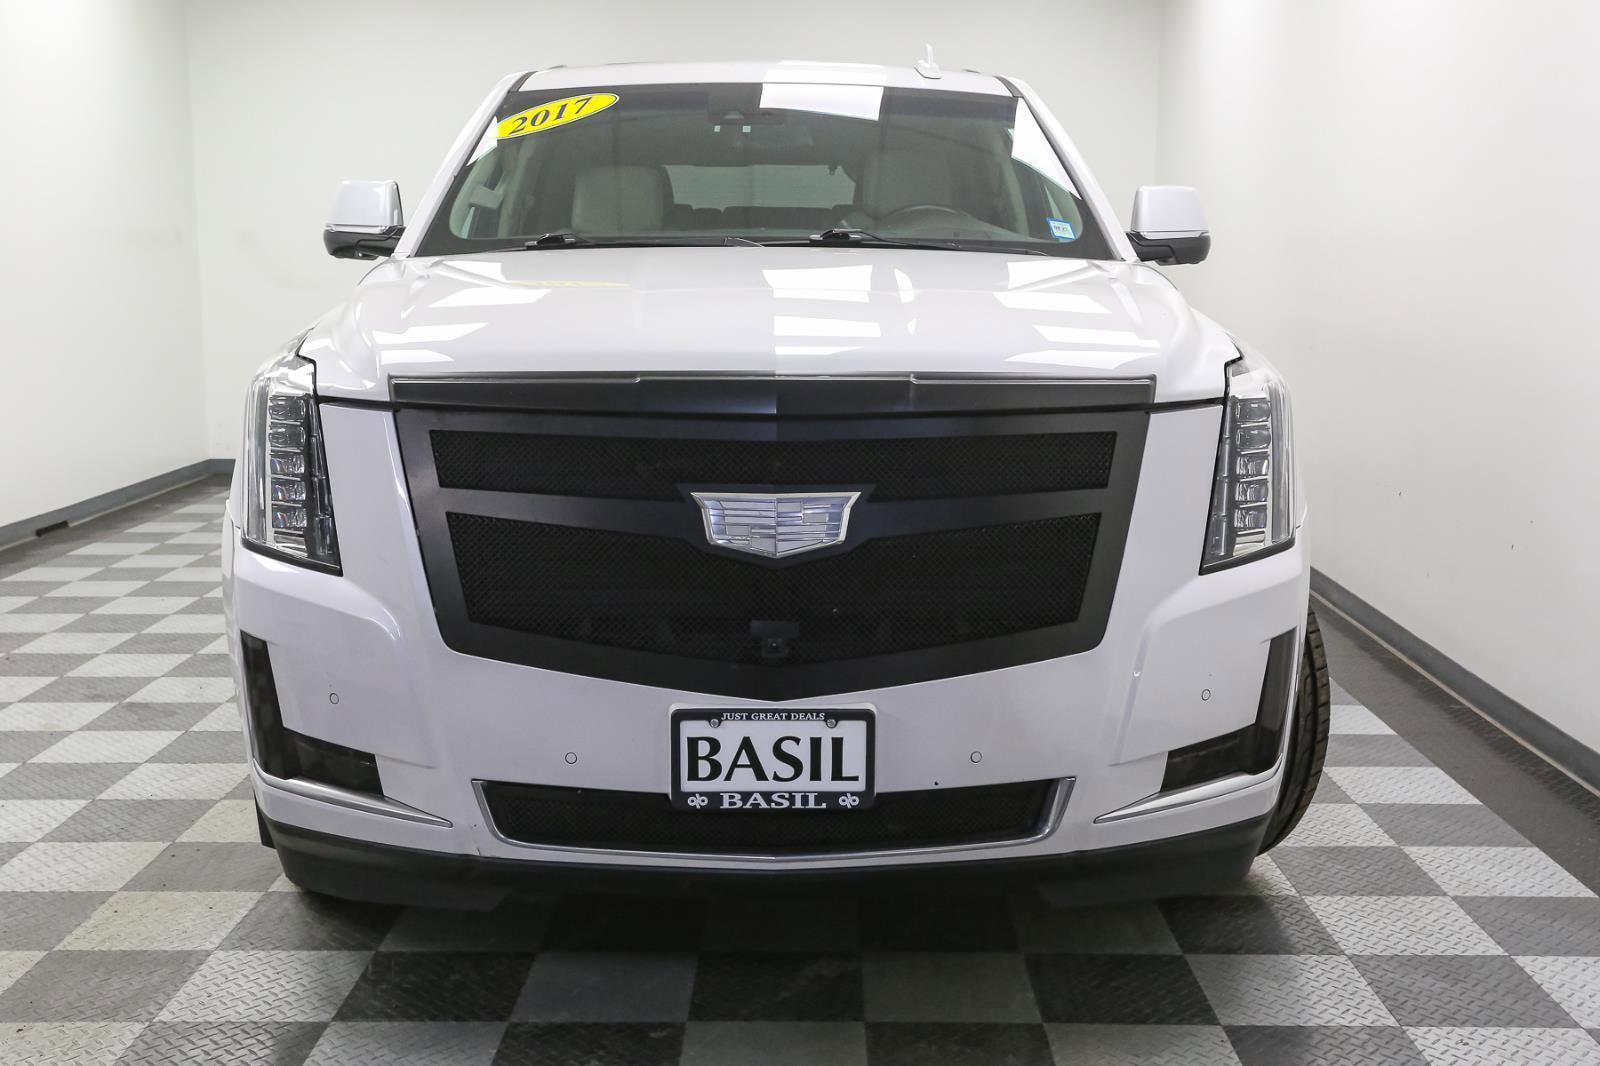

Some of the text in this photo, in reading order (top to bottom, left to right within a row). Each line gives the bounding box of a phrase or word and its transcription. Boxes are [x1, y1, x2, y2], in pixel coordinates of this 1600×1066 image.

[508, 97, 592, 135] 2017
[721, 712, 825, 720] JUST GREAT DEALS
[686, 735, 860, 782] BASIL
[719, 792, 827, 809] BASIL
